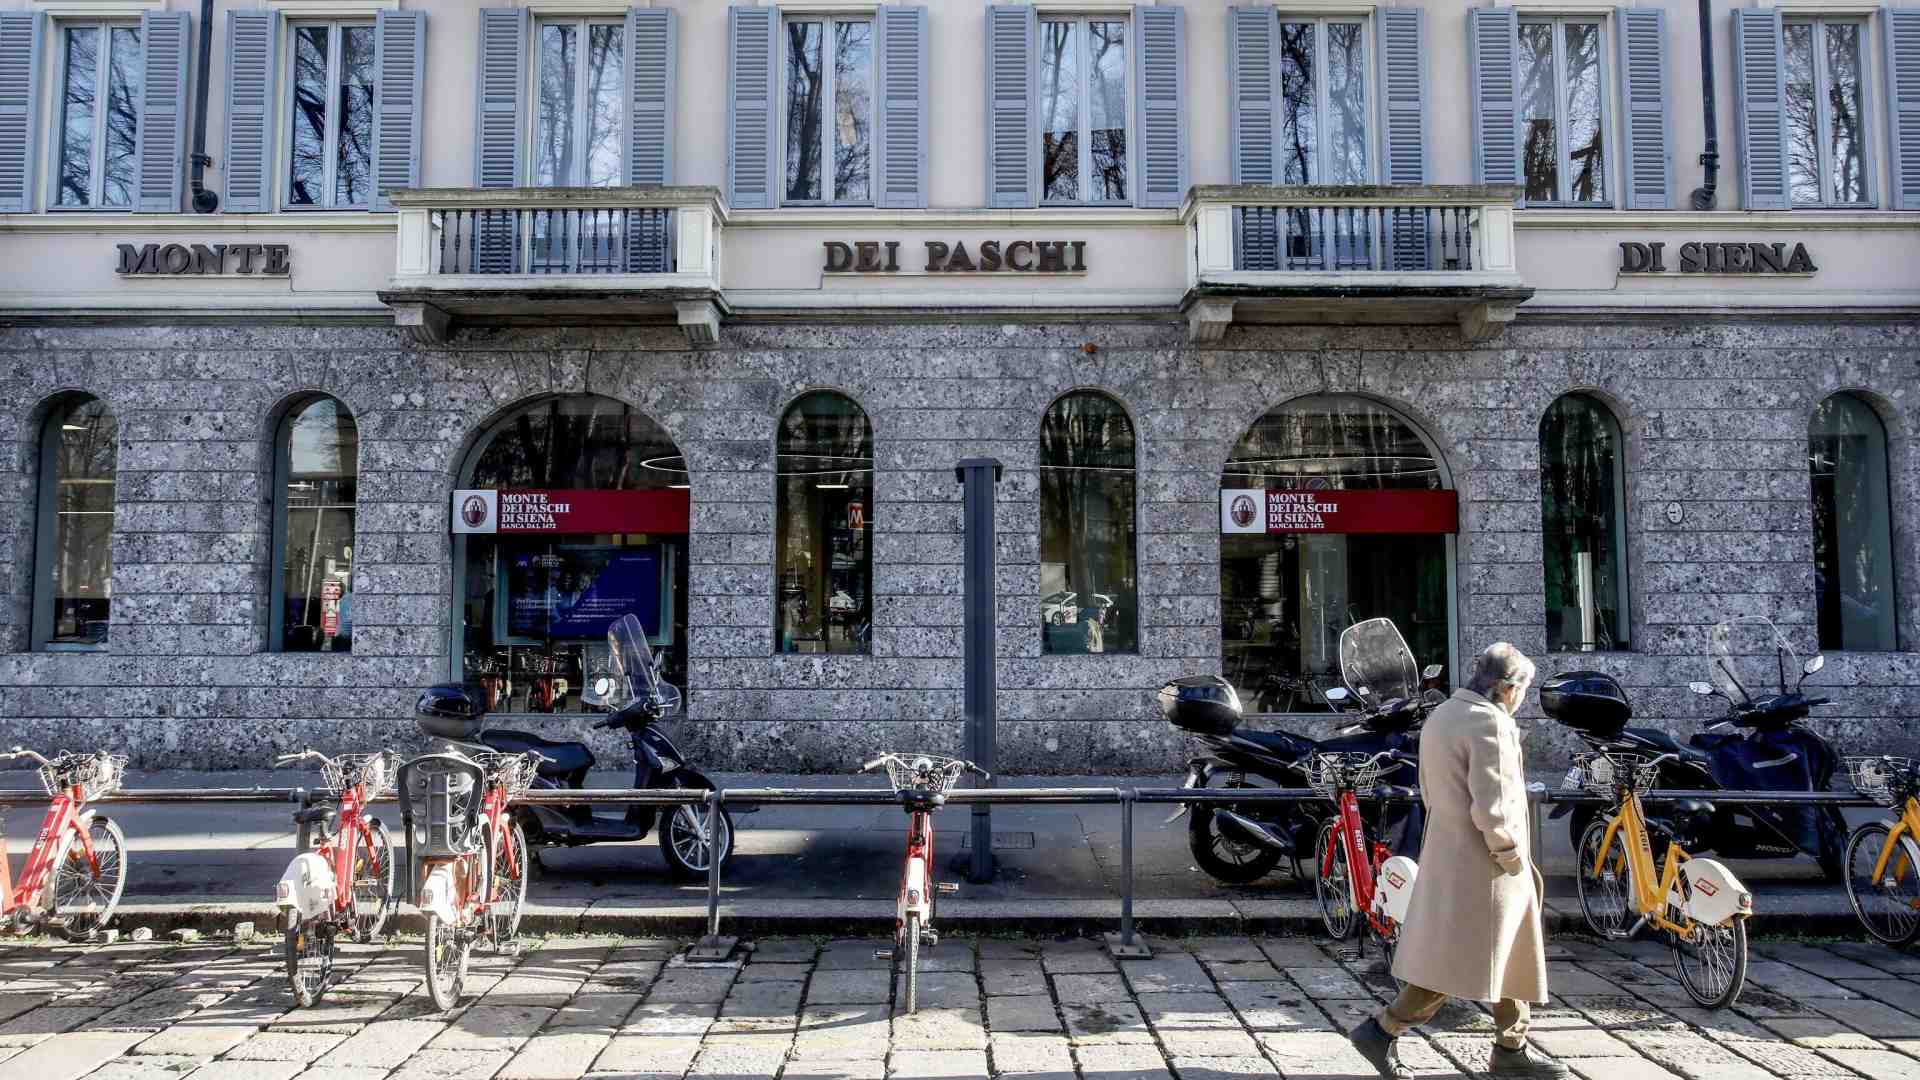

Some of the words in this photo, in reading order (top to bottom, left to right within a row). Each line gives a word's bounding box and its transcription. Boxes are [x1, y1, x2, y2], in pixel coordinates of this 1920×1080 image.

[115, 243, 290, 274] MONTE
[823, 241, 900, 272] DEI
[924, 240, 1087, 272] PASCHI
[1619, 242, 1666, 272] DI
[1679, 242, 1818, 273] SIENA
[502, 494, 548, 503] MONTE
[1269, 493, 1315, 503] MONTE
[502, 503, 523, 513] DEI
[526, 503, 570, 513] PASCHI
[1269, 503, 1291, 513] DEI
[1293, 503, 1338, 513] PASCHI
[502, 513, 515, 523] DI
[516, 513, 554, 523] SIENA
[1269, 513, 1283, 523] DI
[1284, 513, 1323, 523] SIENA
